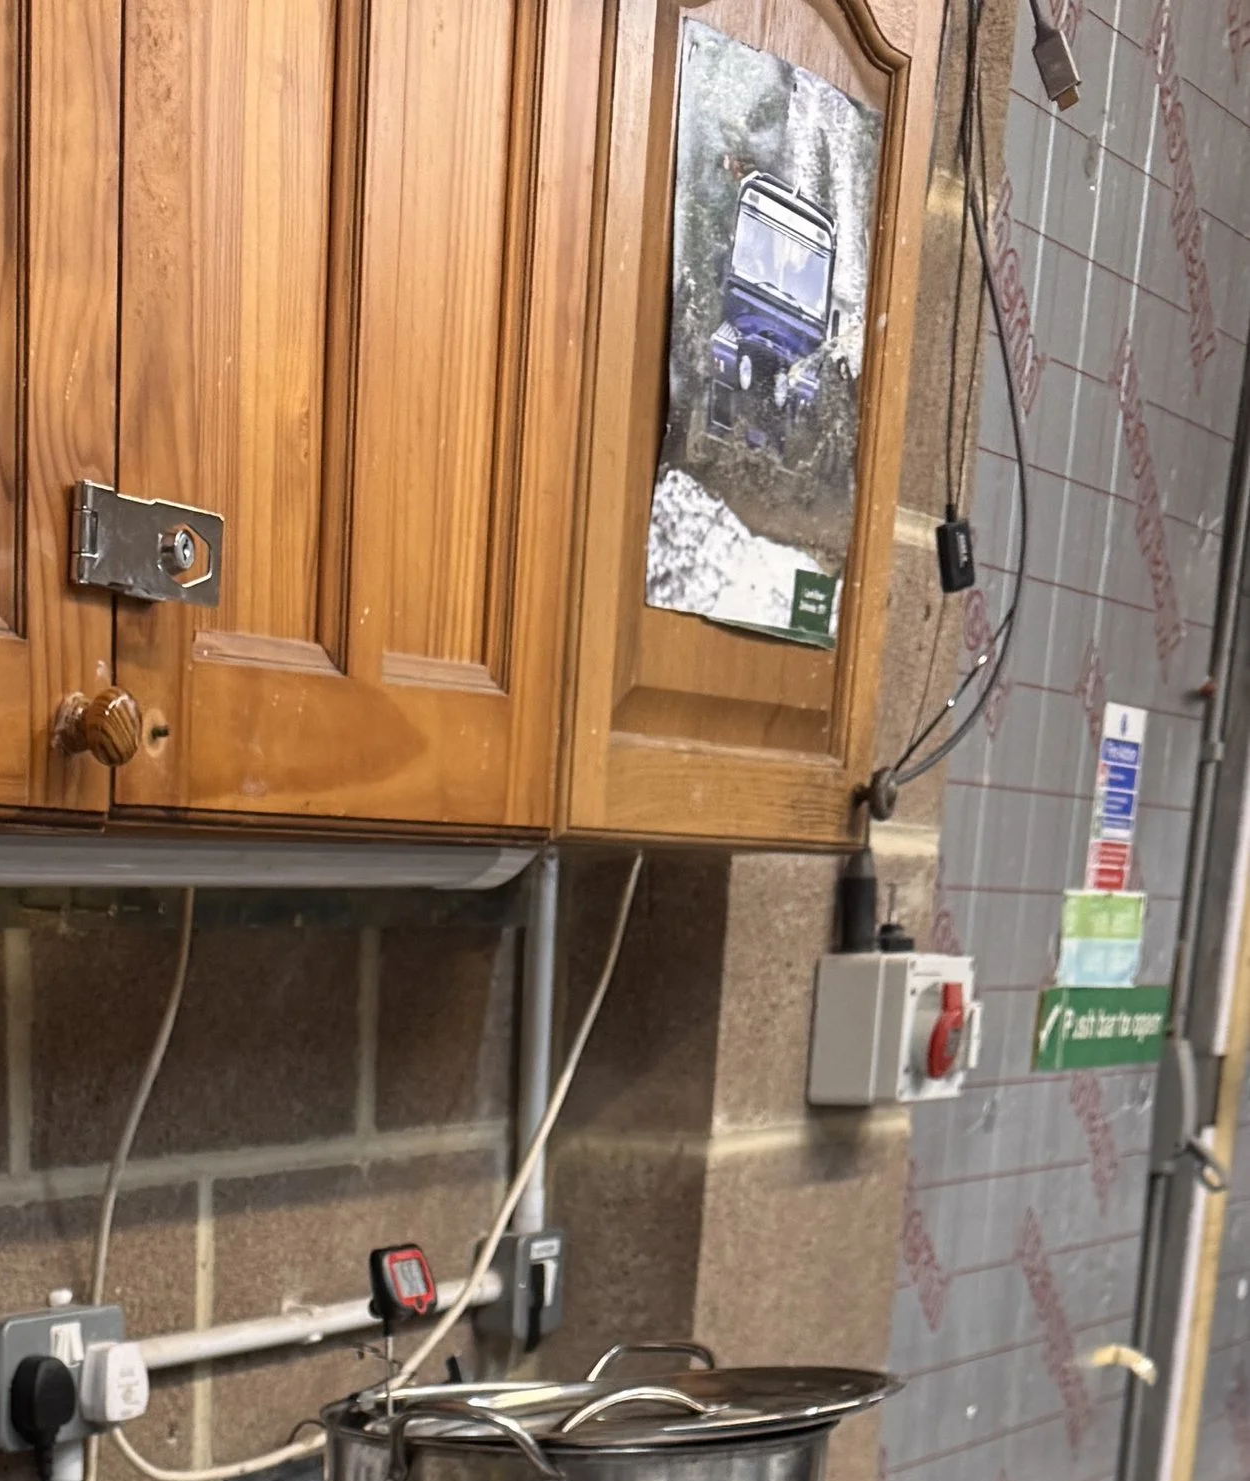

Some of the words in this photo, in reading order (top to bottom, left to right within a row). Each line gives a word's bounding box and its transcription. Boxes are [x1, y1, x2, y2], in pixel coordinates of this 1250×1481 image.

[1062, 1006, 1095, 1043] Push
[1097, 1006, 1117, 1040] bar
[1132, 1012, 1162, 1045] open
